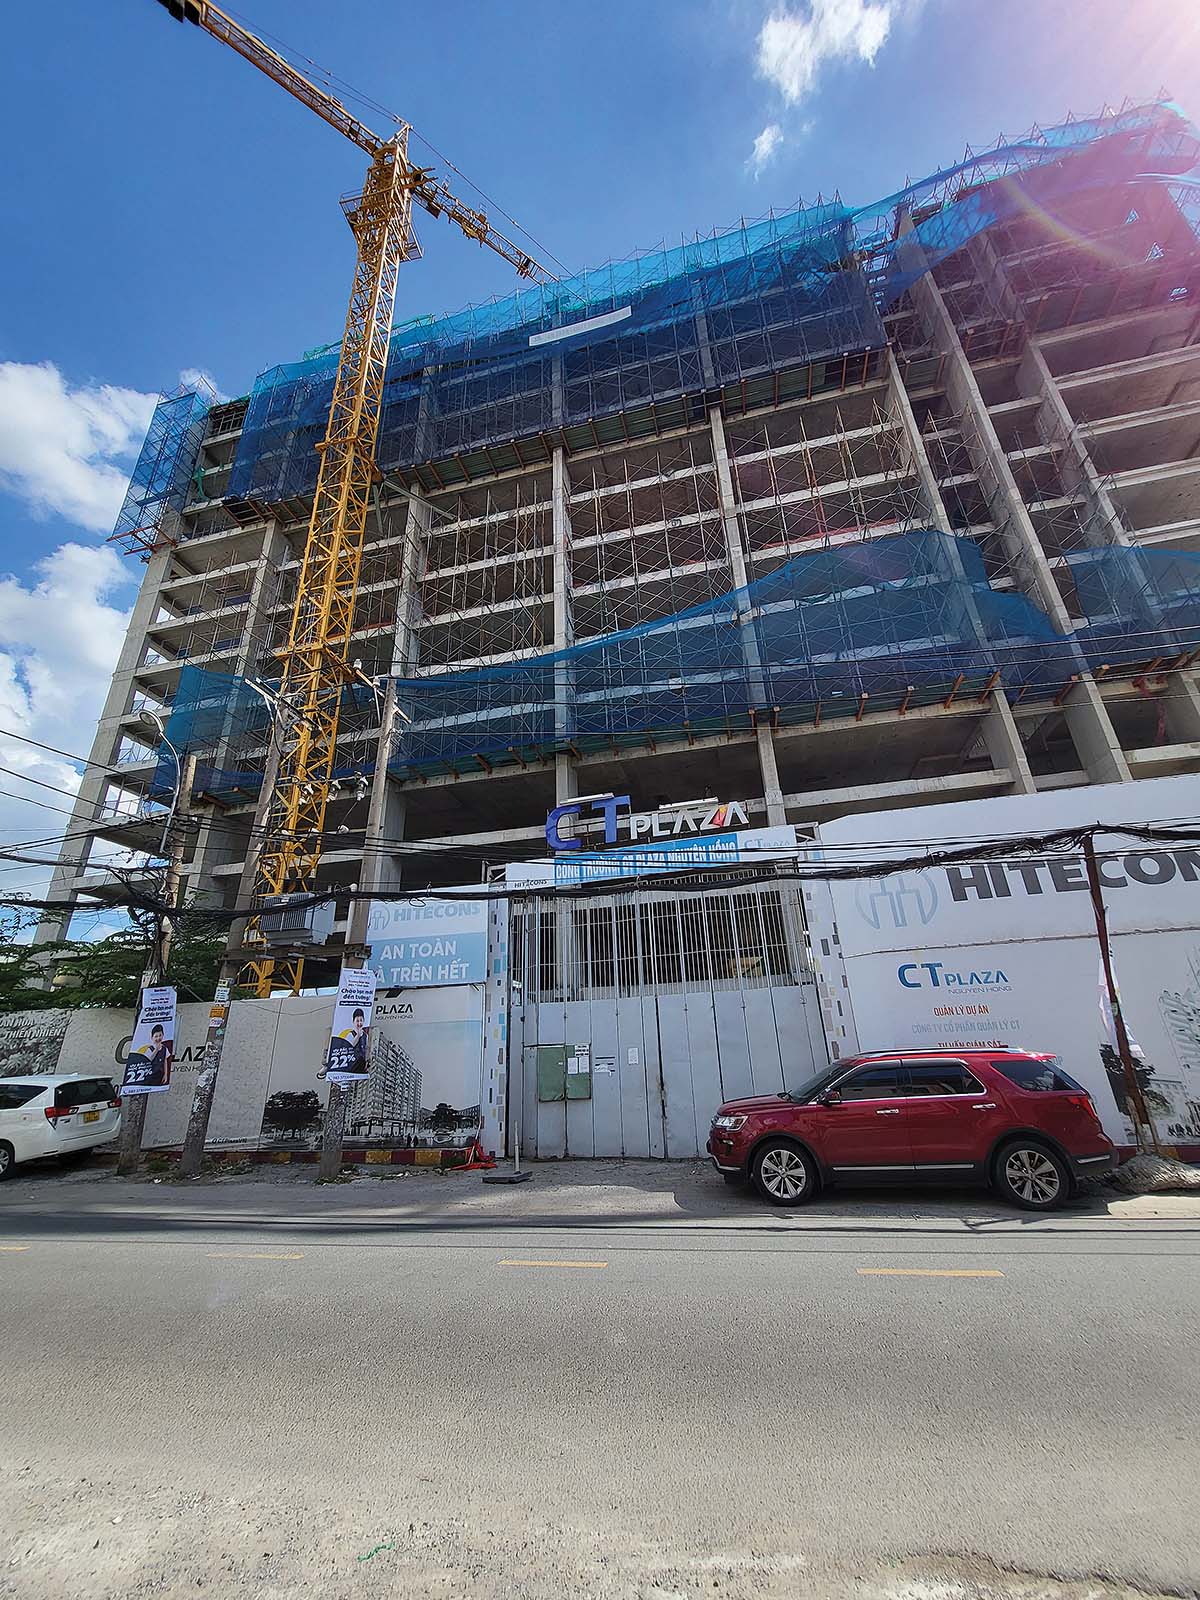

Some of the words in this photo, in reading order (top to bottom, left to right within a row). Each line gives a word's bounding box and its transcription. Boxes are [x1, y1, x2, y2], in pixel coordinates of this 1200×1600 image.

[545, 794, 631, 849] CT
[629, 801, 750, 840] PLAZA
[393, 903, 481, 922] HITECONS
[380, 943, 404, 960] AN
[409, 938, 457, 959] TOÀN
[390, 962, 433, 982] TRÊN
[437, 958, 470, 980] HẾT
[897, 961, 943, 988] CT
[943, 970, 1010, 987] PLAZA
[375, 1003, 414, 1015] PLAZA
[330, 1054, 356, 1069] 22%
[126, 1068, 153, 1083] 22%
